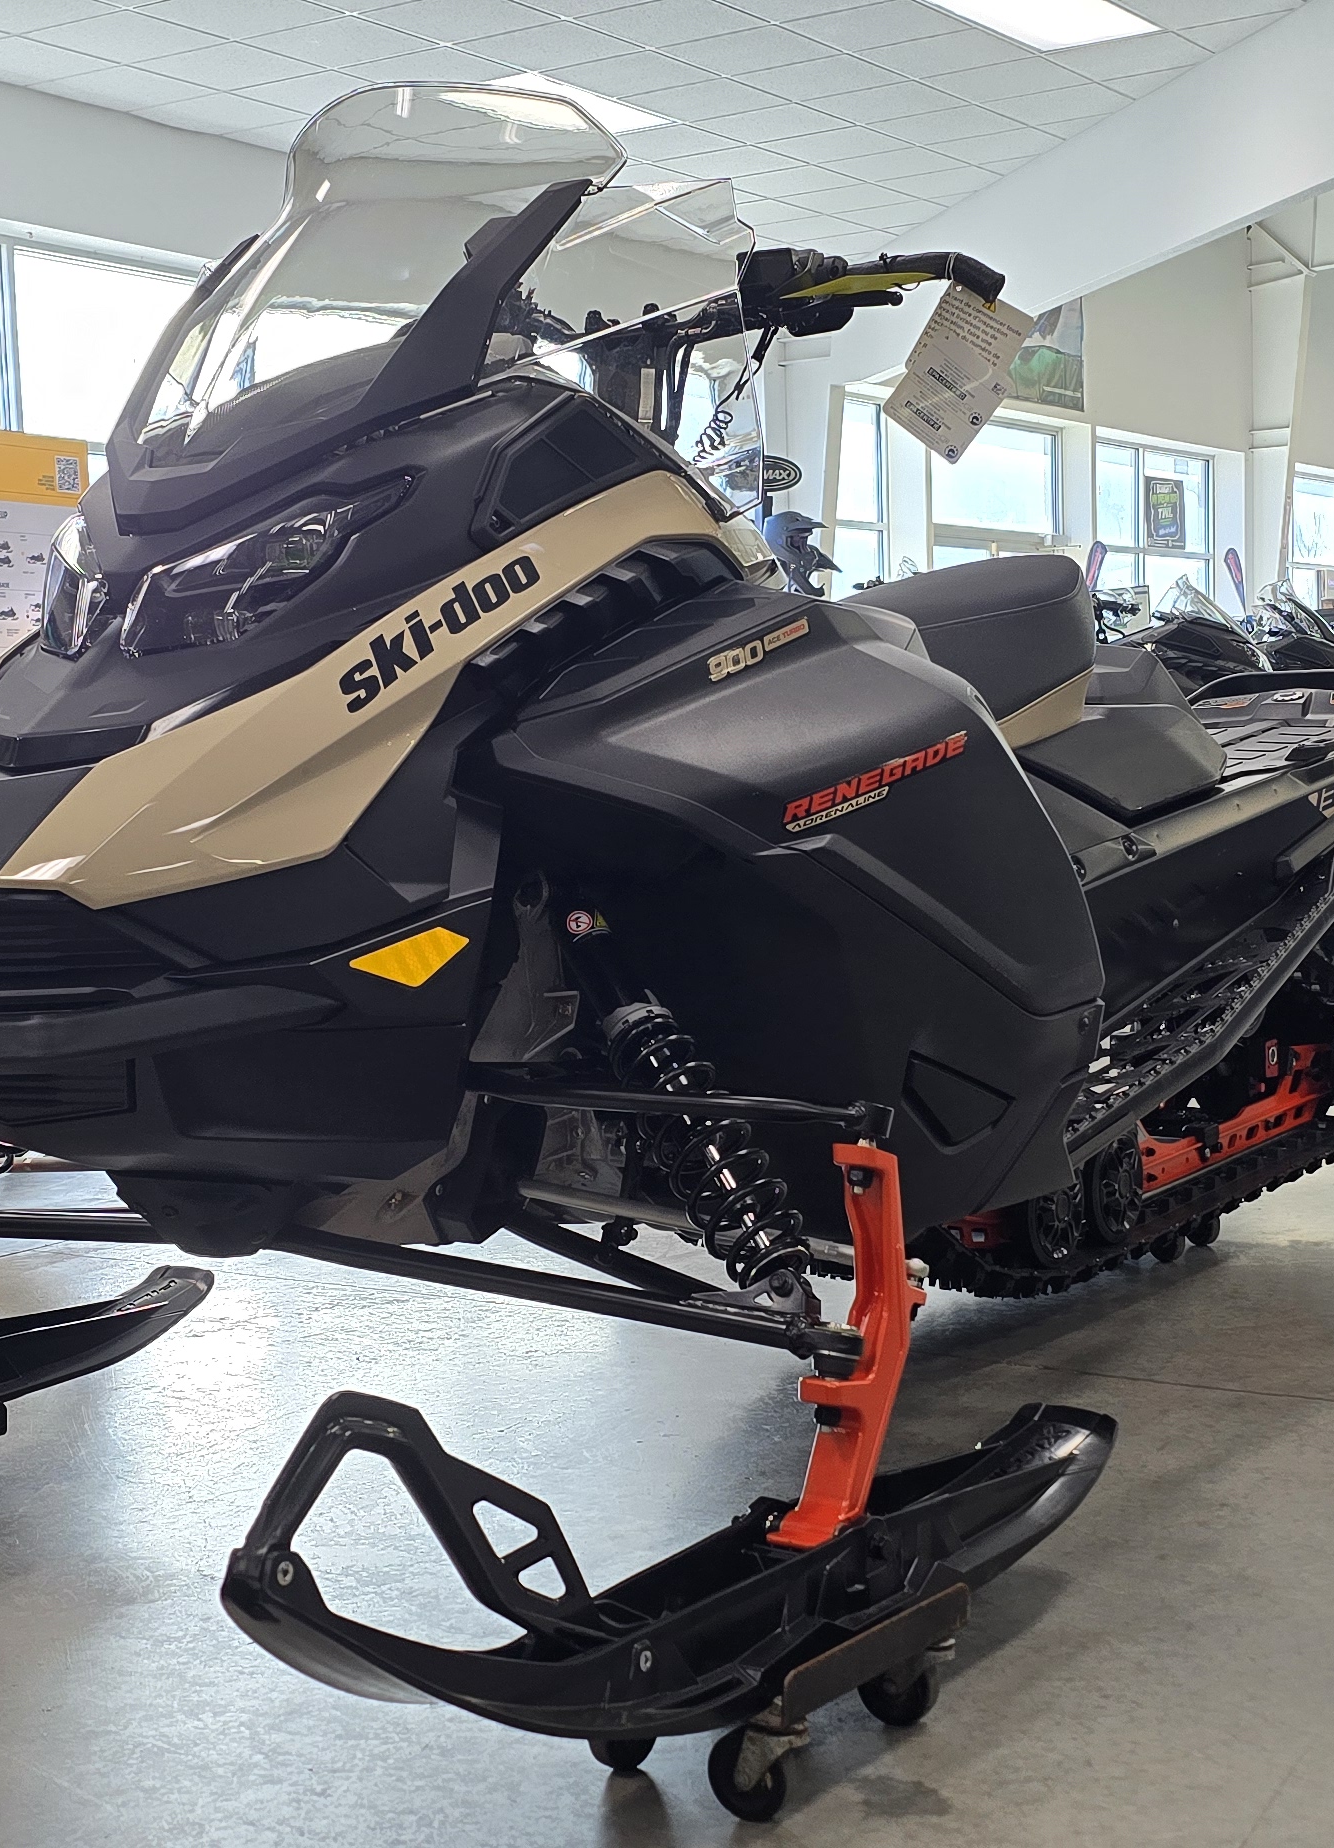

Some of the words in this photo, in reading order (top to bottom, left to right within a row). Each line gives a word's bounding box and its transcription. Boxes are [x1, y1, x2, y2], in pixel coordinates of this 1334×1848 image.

[963, 300, 972, 308] de
[972, 305, 1006, 328] commencer
[1005, 324, 1022, 336] toute
[966, 328, 980, 340] faire
[960, 333, 969, 342] du
[992, 351, 1000, 360] de
[989, 332, 998, 341] de
[764, 469, 790, 480] MAX
[339, 556, 540, 713] ski-doo
[708, 639, 763, 682] 900
[767, 634, 782, 647] ACE
[782, 622, 806, 640] TURBO
[784, 732, 967, 822] RENEGADE
[792, 788, 887, 830] ADRENALINE
